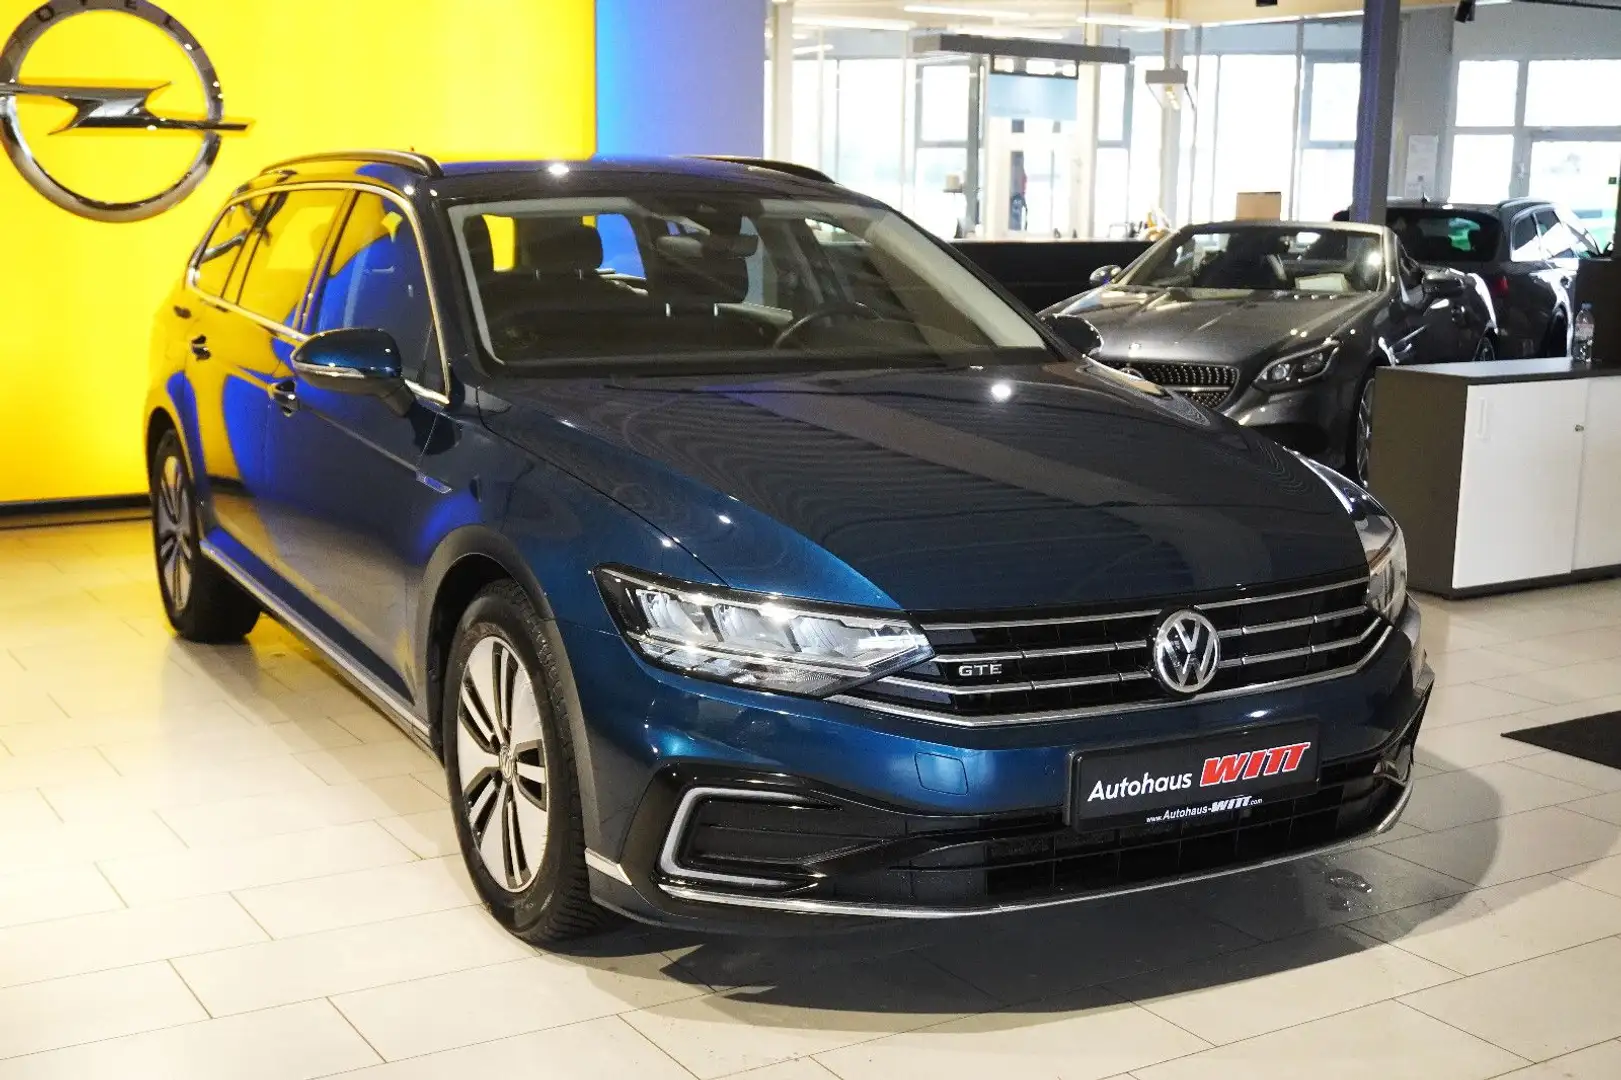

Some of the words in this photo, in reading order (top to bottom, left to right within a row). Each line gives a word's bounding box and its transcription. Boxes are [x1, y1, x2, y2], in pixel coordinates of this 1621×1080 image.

[958, 663, 1003, 677] GTE
[1087, 771, 1193, 802] Autohaus
[1199, 741, 1311, 787] WITT
